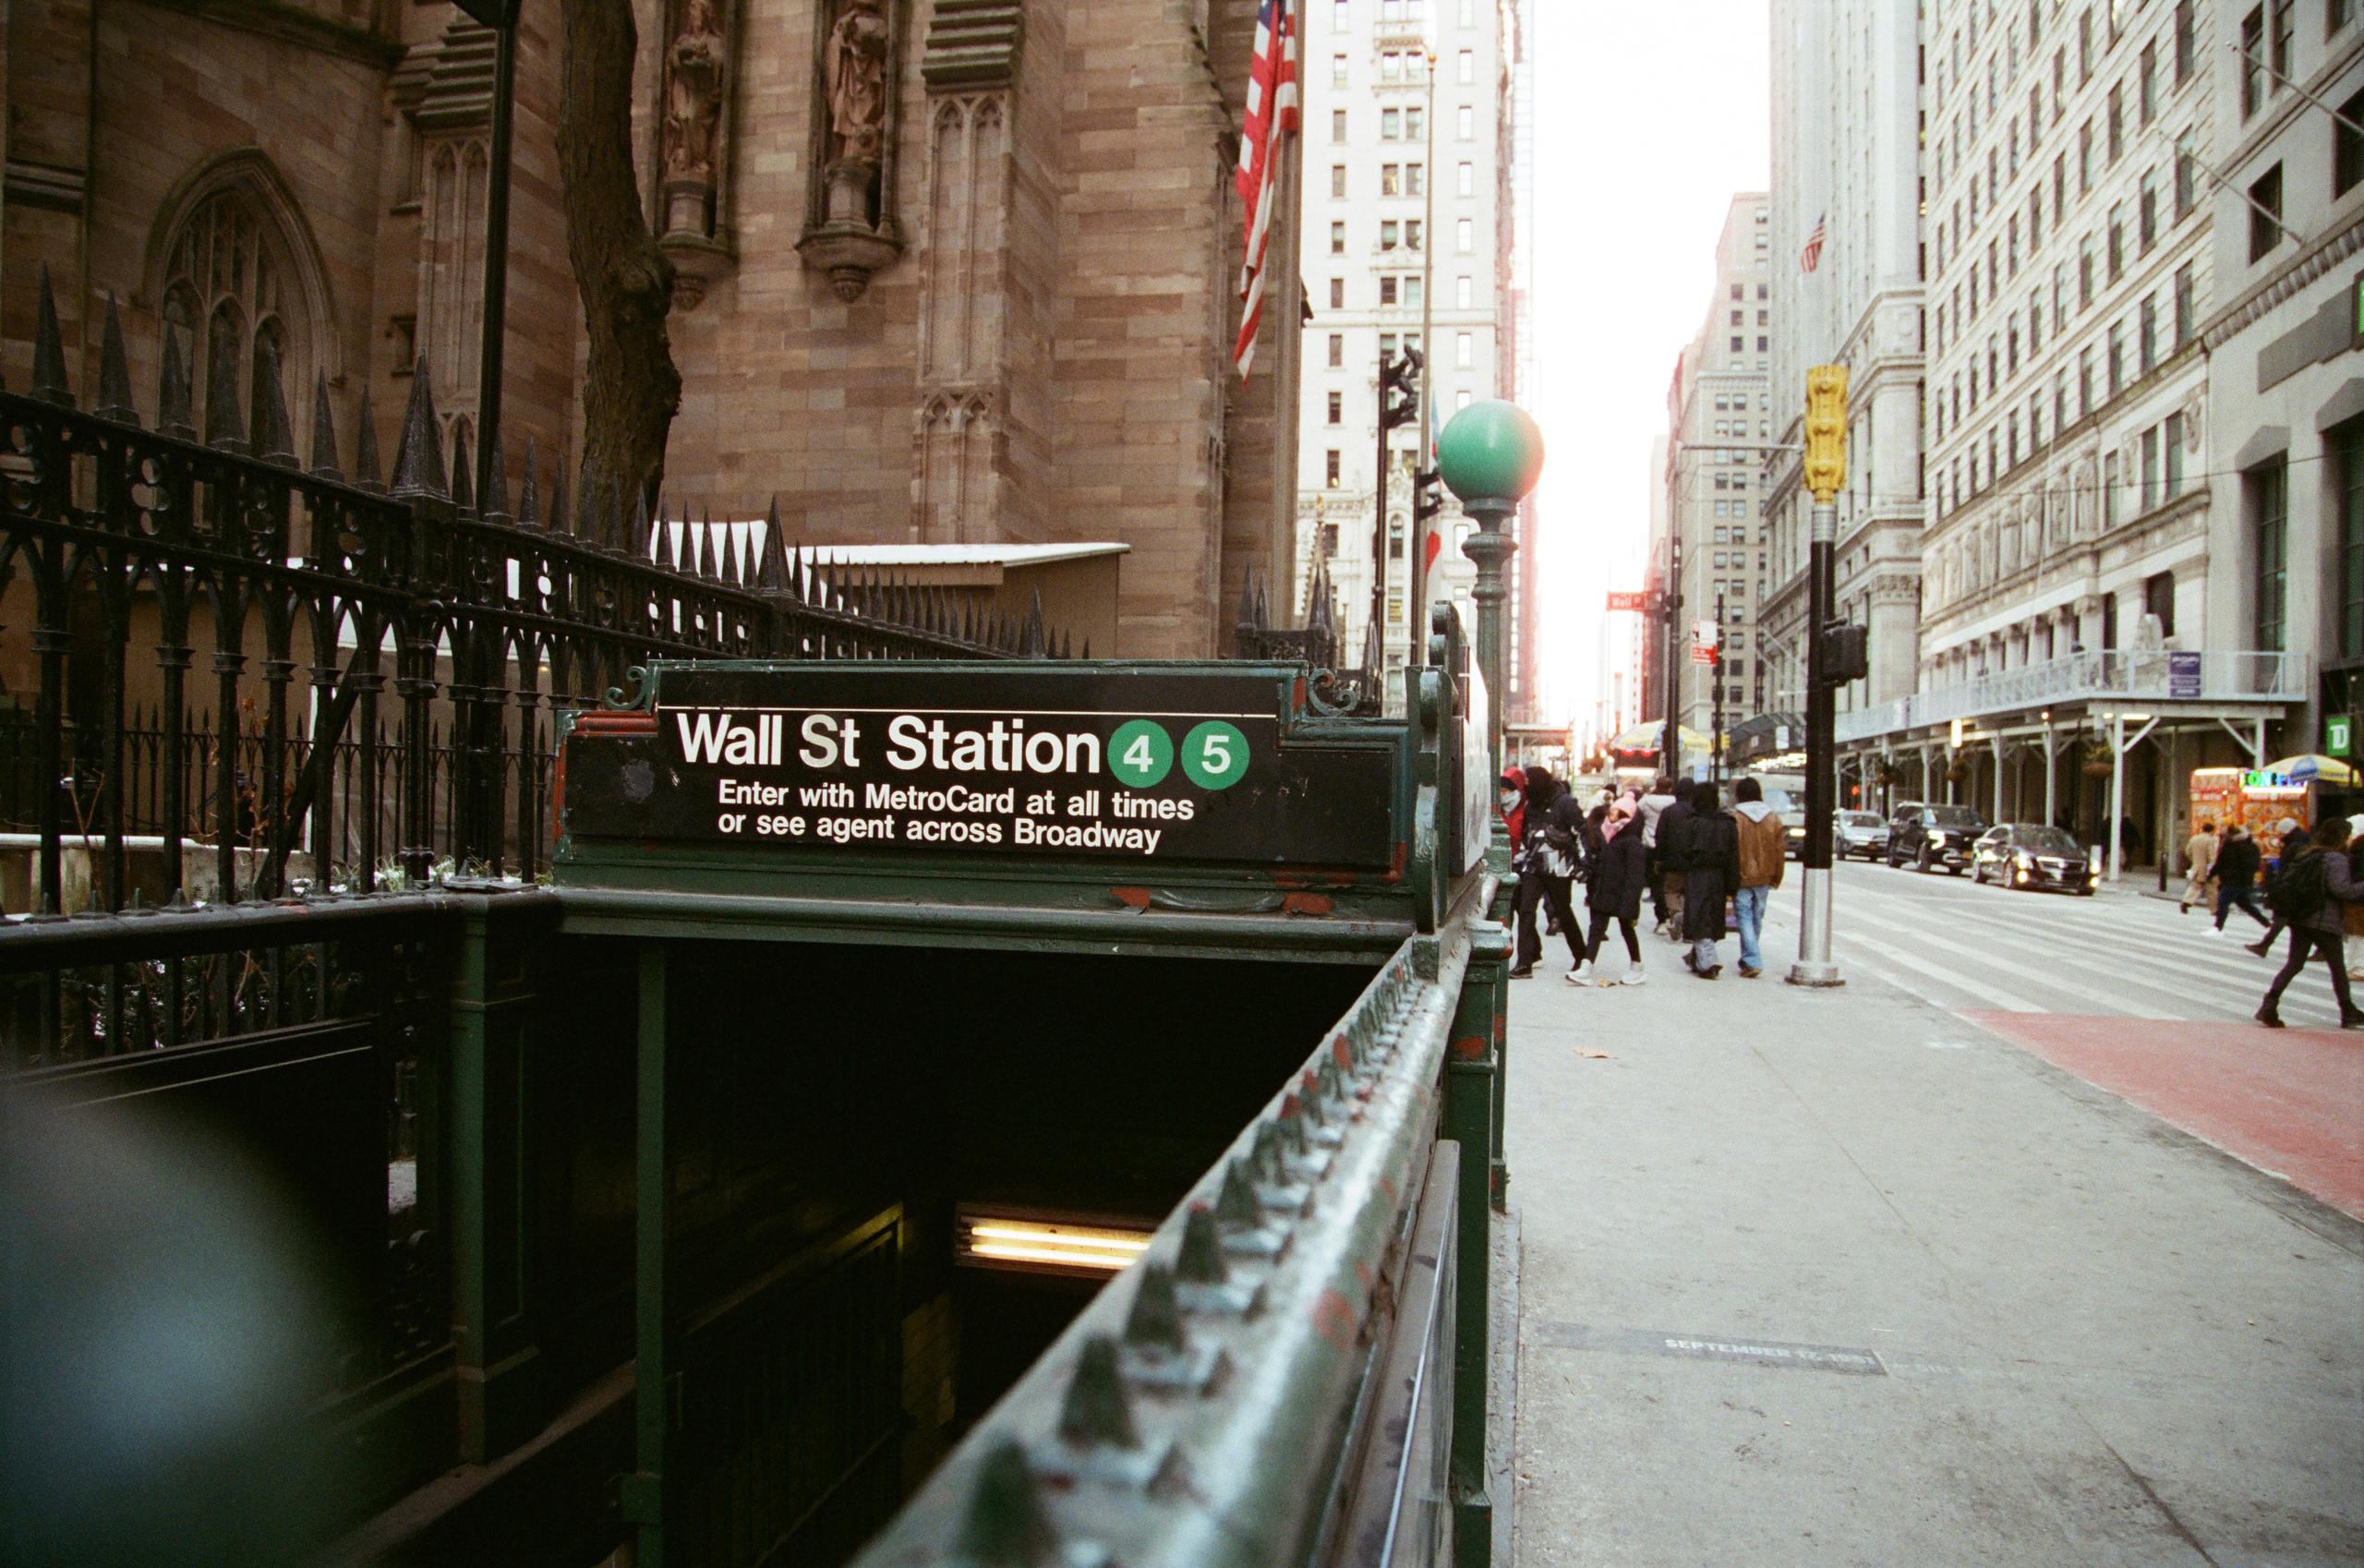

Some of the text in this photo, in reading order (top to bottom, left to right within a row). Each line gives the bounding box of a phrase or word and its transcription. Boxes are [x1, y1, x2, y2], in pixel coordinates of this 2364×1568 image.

[676, 713, 1232, 774] Wall St Station 4 5
[2329, 724, 2348, 749] TD
[718, 778, 1194, 821] Enter with MetroCard at all times
[718, 814, 1162, 855] or see agent across Broadway
[1665, 1338, 1792, 1358] SEPTEMBER
